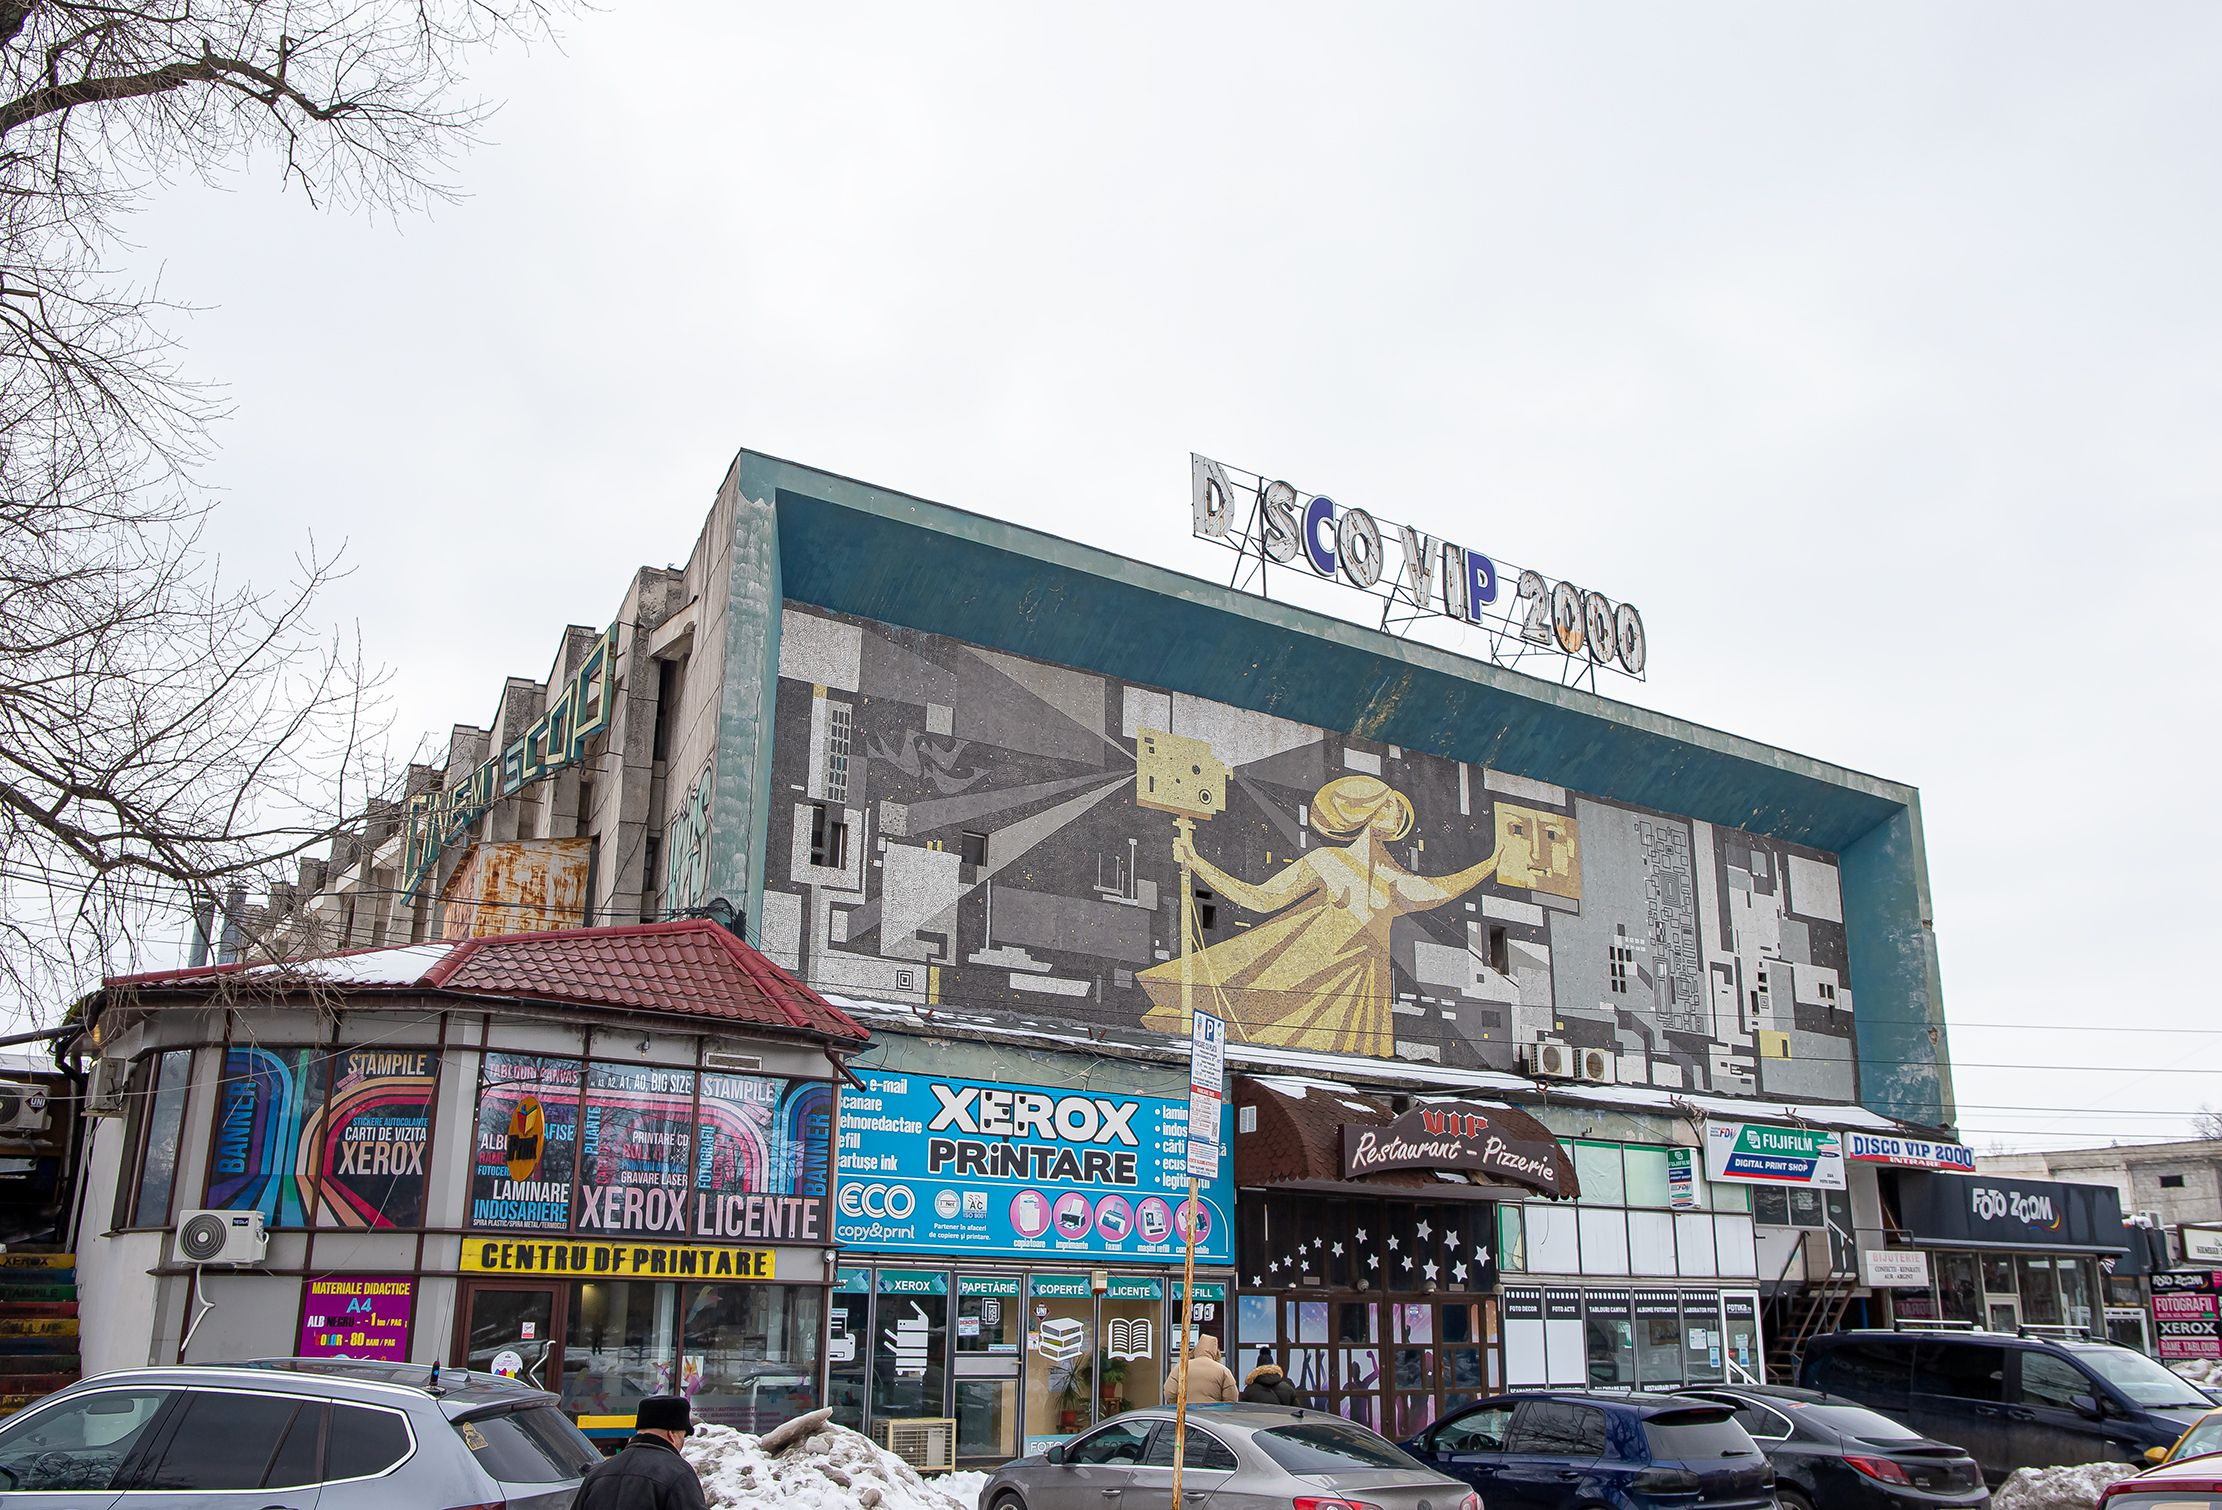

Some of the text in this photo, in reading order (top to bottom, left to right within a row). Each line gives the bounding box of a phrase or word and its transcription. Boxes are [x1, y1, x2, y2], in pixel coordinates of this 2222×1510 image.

[1398, 525, 1498, 625] VIP
[1518, 569, 1647, 674] 2000
[347, 1053, 428, 1076] STAMPILE
[489, 1063, 579, 1084] TABLOURI CANVAS
[619, 1076, 631, 1091] A1,
[651, 1073, 667, 1092] BIG
[670, 1074, 691, 1094] SIZE
[703, 1077, 775, 1101] STAMPILE
[869, 1078, 908, 1094] e-mail
[31, 1097, 46, 1107] UNI
[927, 1083, 1140, 1147] XEROX
[1162, 1104, 1189, 1121] lamin
[217, 1082, 257, 1173] BANNER
[352, 1117, 429, 1127] STICKERE AUTOCOLANTE
[584, 1106, 601, 1155] PLIANTE
[840, 1113, 923, 1134] ehnoredactare
[1162, 1122, 1188, 1138] îndos
[1420, 1107, 1489, 1140] VIP
[344, 1126, 427, 1141] CARTI DE VIZITA
[632, 1131, 689, 1146] PRINTARE CD
[839, 1132, 861, 1149] efill
[1763, 1133, 1813, 1152] FUJIFILM
[337, 1141, 426, 1175] XEROX
[698, 1125, 716, 1189] FOTOGRAFII
[803, 1113, 830, 1196] BANNER
[1352, 1131, 1462, 1169] Restaurant
[1482, 1134, 1555, 1182] Pizzerie
[1853, 1136, 1974, 1168] DISCO VIP 2000
[880, 1154, 898, 1171] ink
[1162, 1158, 1187, 1171] ecus
[1735, 1158, 1808, 1172] DIGITAL PRINT SHOP
[1889, 1156, 1942, 1168] INTRARE
[477, 1165, 511, 1177] FOTOCER
[621, 1171, 688, 1186] GRAVARE LASER
[492, 1180, 570, 1203] LAMINARE
[579, 1184, 688, 1232] XEROX
[838, 1181, 916, 1220] ECO
[1972, 1188, 2054, 1224] FOTO ZOOM
[473, 1199, 568, 1222] INDOSARIERE
[837, 1222, 915, 1242] copy&print
[933, 1222, 959, 1230] Partener
[4, 1256, 48, 1267] XEROX
[481, 1243, 588, 1270] CENTRU
[633, 1248, 768, 1276] PRINTARE
[1872, 1253, 1921, 1263] BIJUTERIE
[312, 1282, 411, 1295] MATERIALE DIDACTICE
[894, 1280, 930, 1292] XEROX
[1039, 1283, 1084, 1295] COPERTE
[1191, 1287, 1213, 1298] EFILL
[346, 1297, 372, 1313] A4
[2155, 1297, 2214, 1312] FOTOGRAFII
[307, 1315, 326, 1328] ALB
[326, 1316, 355, 1328] NEGRU
[2159, 1322, 2217, 1334] XEROX
[315, 1334, 343, 1347] COLOR
[350, 1332, 365, 1347] 80
[384, 1339, 396, 1347] PAG
